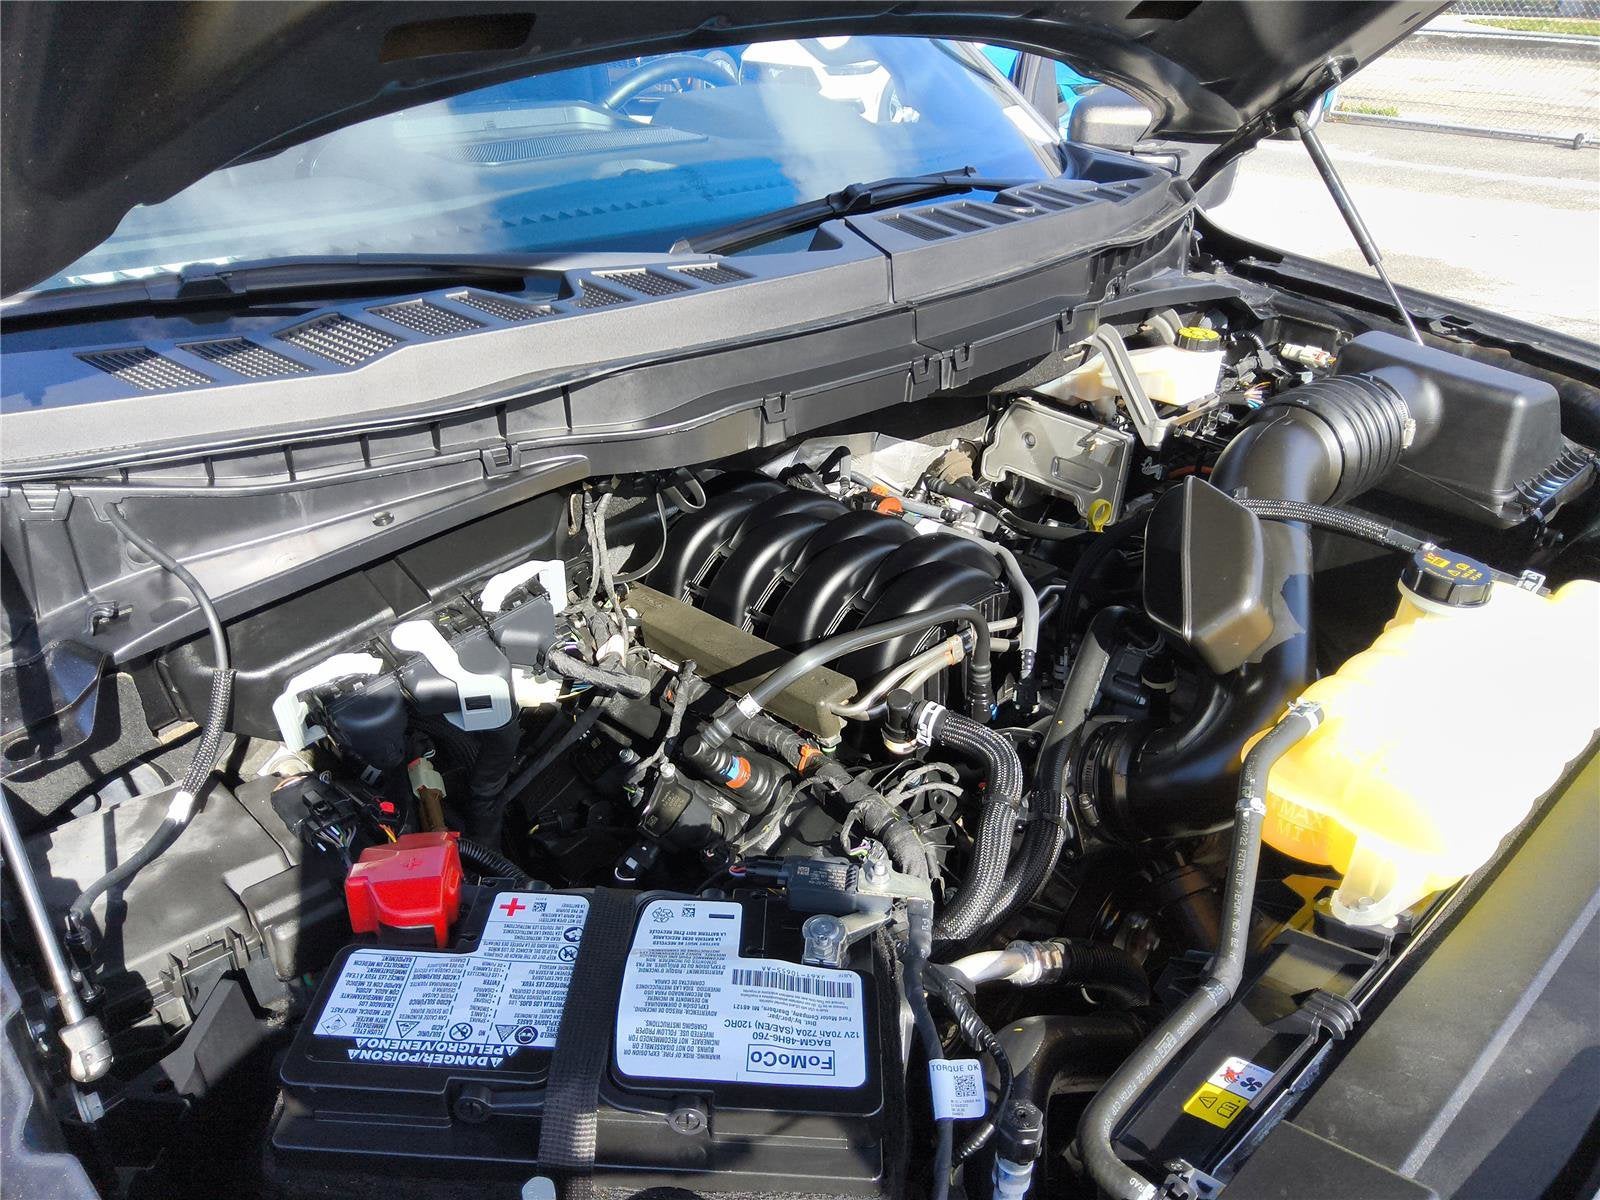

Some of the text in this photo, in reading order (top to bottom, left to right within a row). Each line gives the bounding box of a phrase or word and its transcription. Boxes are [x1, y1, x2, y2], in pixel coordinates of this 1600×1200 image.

[724, 1019, 752, 1028] 120RC
[755, 1020, 793, 1035] (SAE/EN)
[752, 1031, 831, 1047] BAGM-48H6-760
[796, 1028, 817, 1037] 720A
[368, 1039, 504, 1054] PELIGRO/VENENO
[358, 1050, 488, 1066] DANGER/POISON
[750, 1051, 832, 1070] FoMoCo
